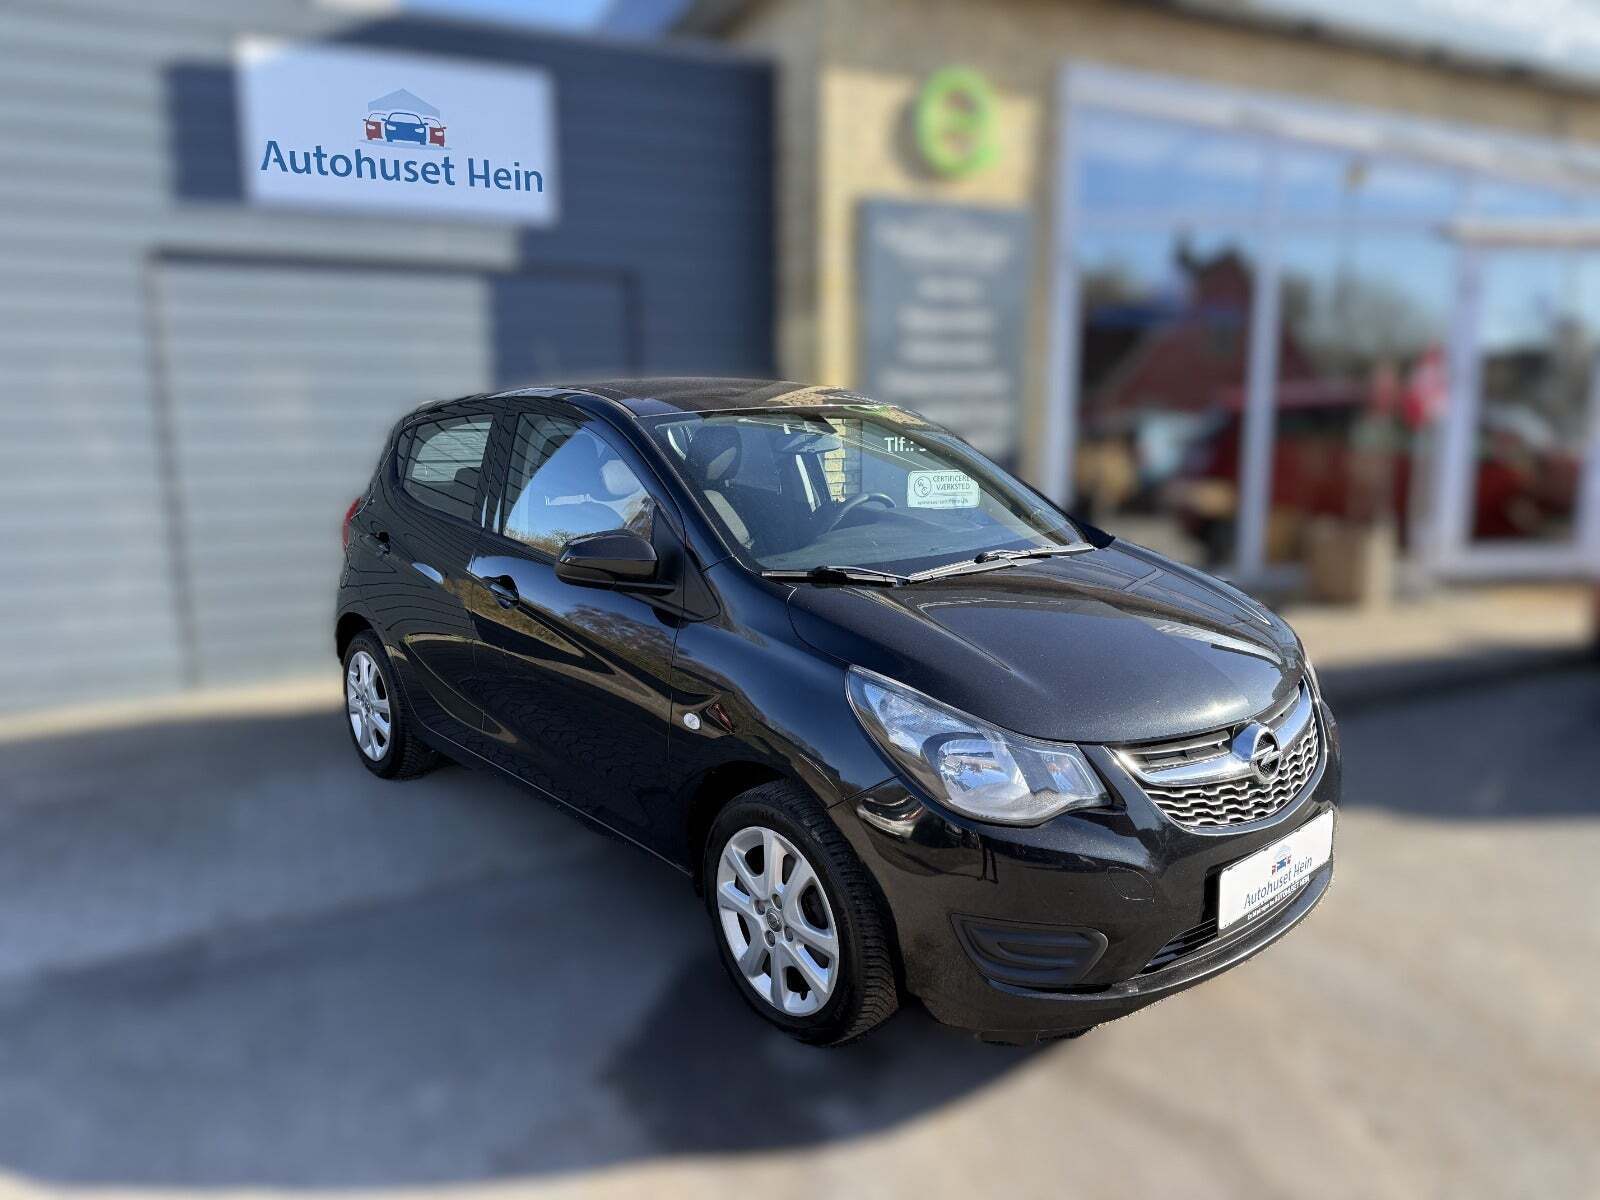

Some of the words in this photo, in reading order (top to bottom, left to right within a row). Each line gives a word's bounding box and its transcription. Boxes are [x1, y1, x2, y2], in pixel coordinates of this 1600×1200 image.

[260, 140, 456, 186] Autohuset
[467, 157, 543, 193] Hein
[1244, 870, 1292, 909] Autohuset
[1294, 856, 1312, 878] Hein
